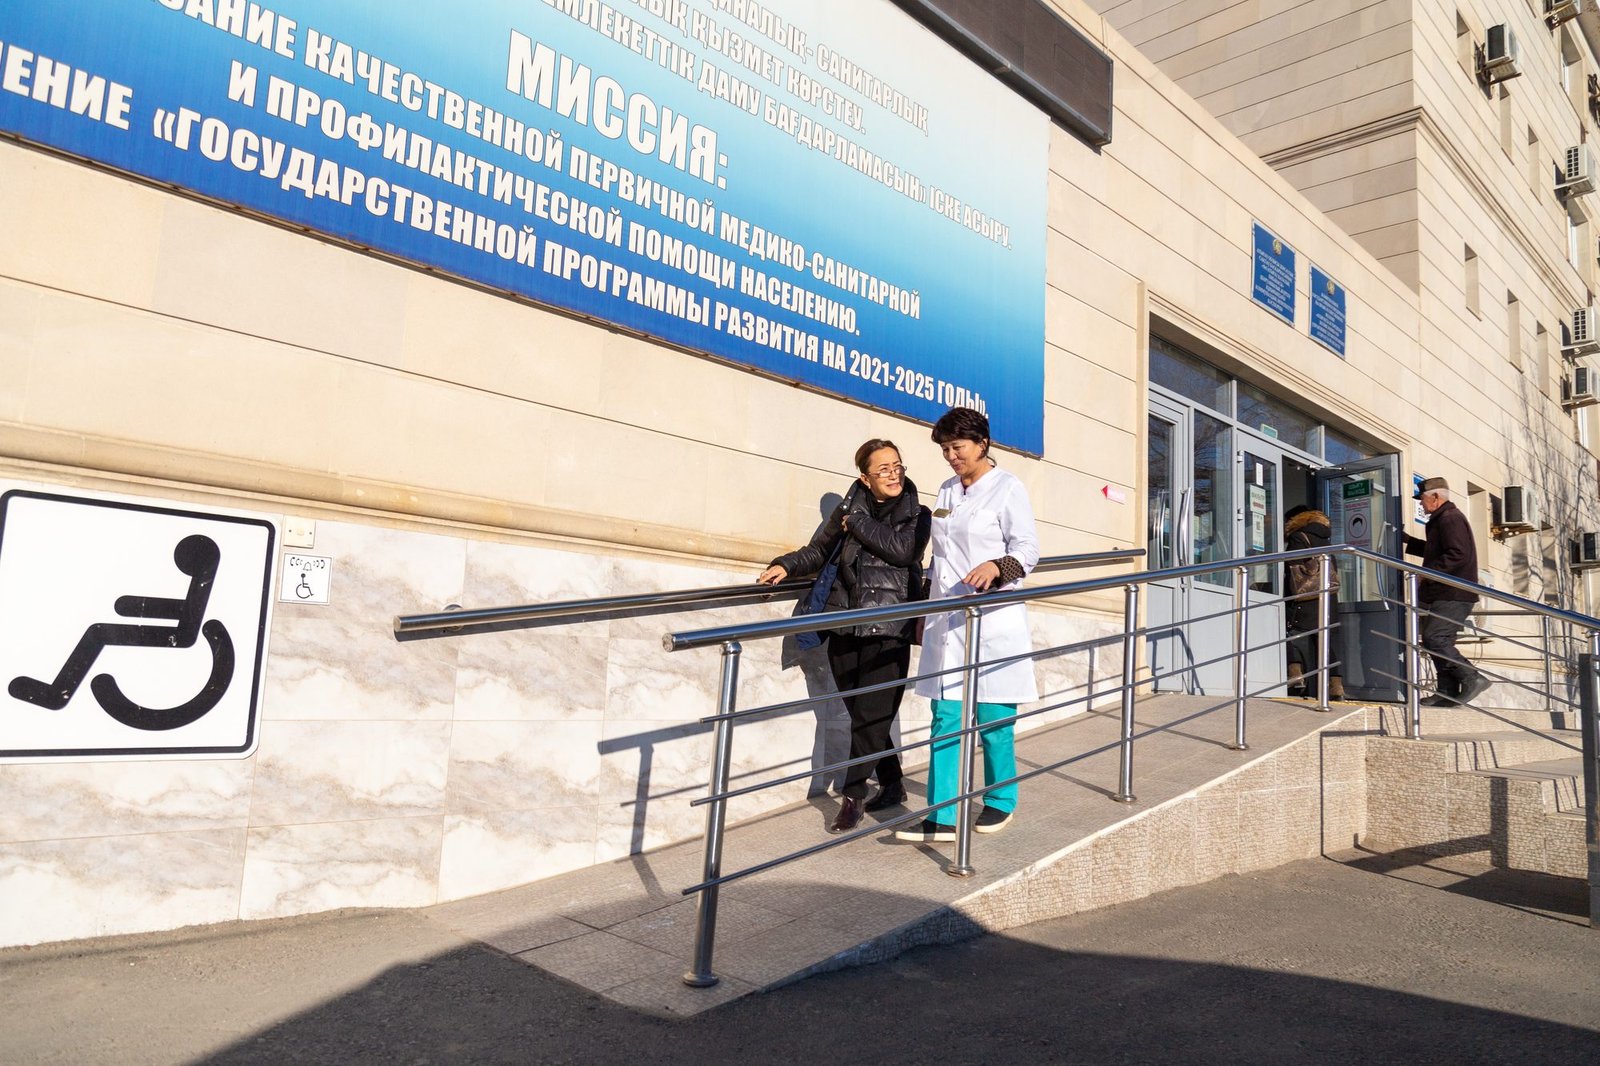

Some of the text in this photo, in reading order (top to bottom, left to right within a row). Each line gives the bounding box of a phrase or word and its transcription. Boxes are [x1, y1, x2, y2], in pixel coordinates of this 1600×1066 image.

[304, 27, 564, 172] КАЧЕСТВЕННОЙ
[569, 145, 715, 236] ПЕРВИЧНОЙ
[720, 211, 920, 320] МЕДИКО-САНИТАРНОЙ
[506, 28, 728, 190] МИССИЯ:
[540, 0, 1012, 250] МЛЕКЕТТІК ДАМУ БАҒДАРЛАМАСЫН» ІСКЕ АСЫРУ.
[692, 9, 784, 86] ҚЫЗМЕТ
[787, 65, 866, 135] КӨРСТЕУ.
[707, 0, 929, 137] НАЛЫҚ- САНИТАРЛЫҚ
[0, 40, 989, 419] ЕНИЕ «ГОСУДАРСТВЕННОЙ ПРОГРАММЫ РАЗВИТИЯ НА 2021-2025 ГОДЫ».
[228, 59, 860, 336] И ПРОФИЛАКТИЧЕСКОЙ ПОМОЩИ НАСЕЛЕНИЮ.
